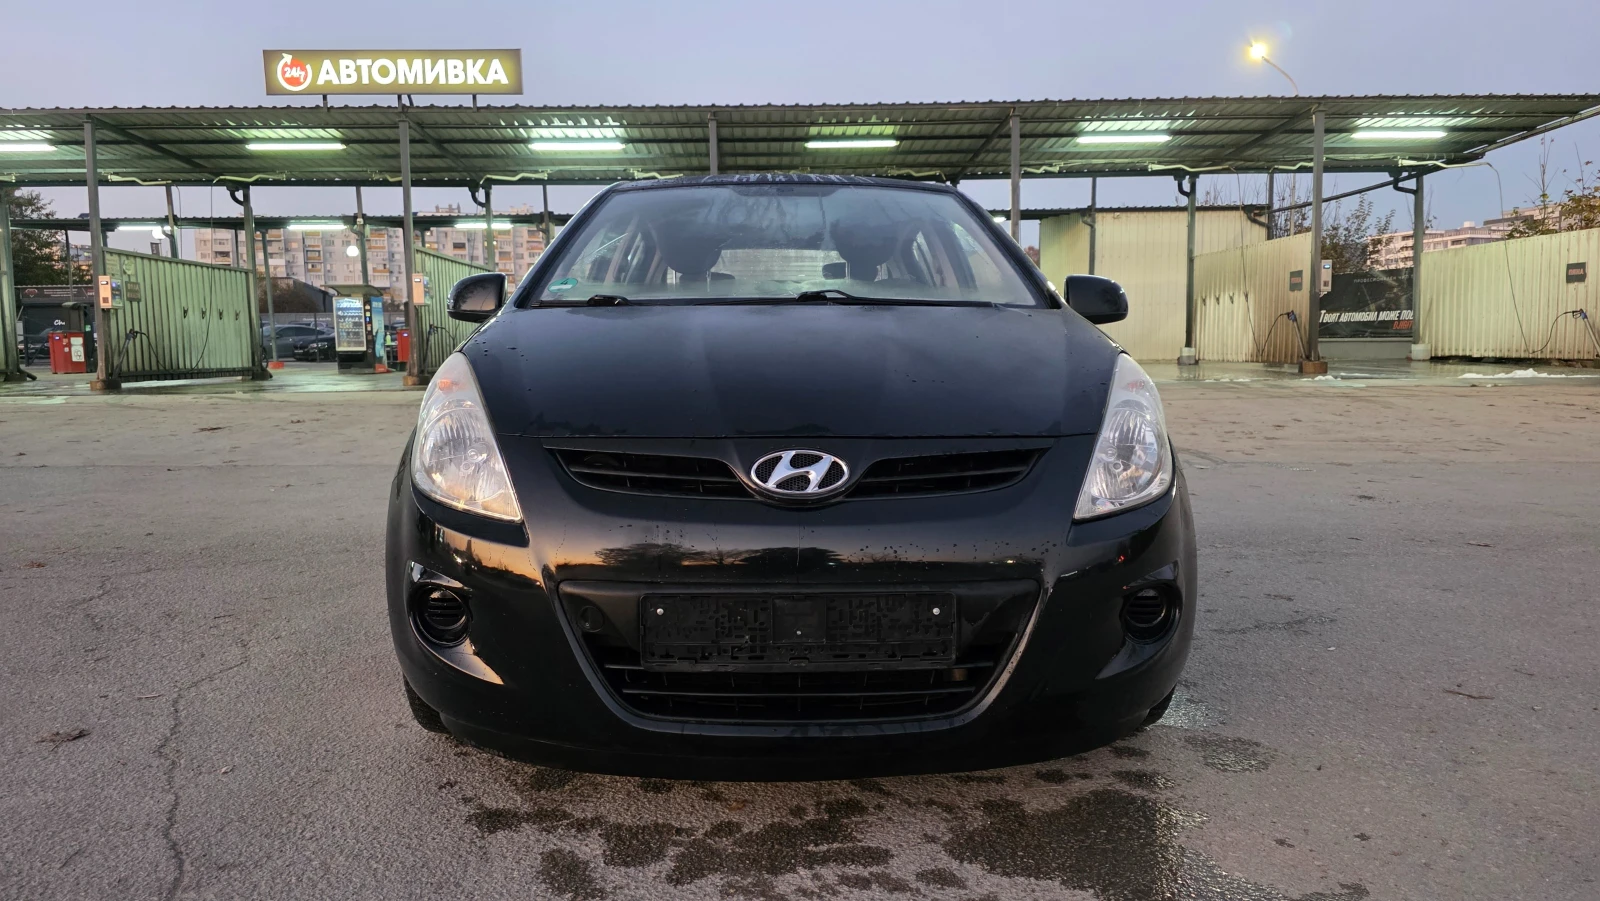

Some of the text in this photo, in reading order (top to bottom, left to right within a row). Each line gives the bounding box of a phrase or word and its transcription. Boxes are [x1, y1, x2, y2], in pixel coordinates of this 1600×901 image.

[316, 58, 509, 85] АВТОМИВКА
[1339, 311, 1377, 322] АВТОМОБИЛ
[1377, 310, 1400, 321] МОЖЕ
